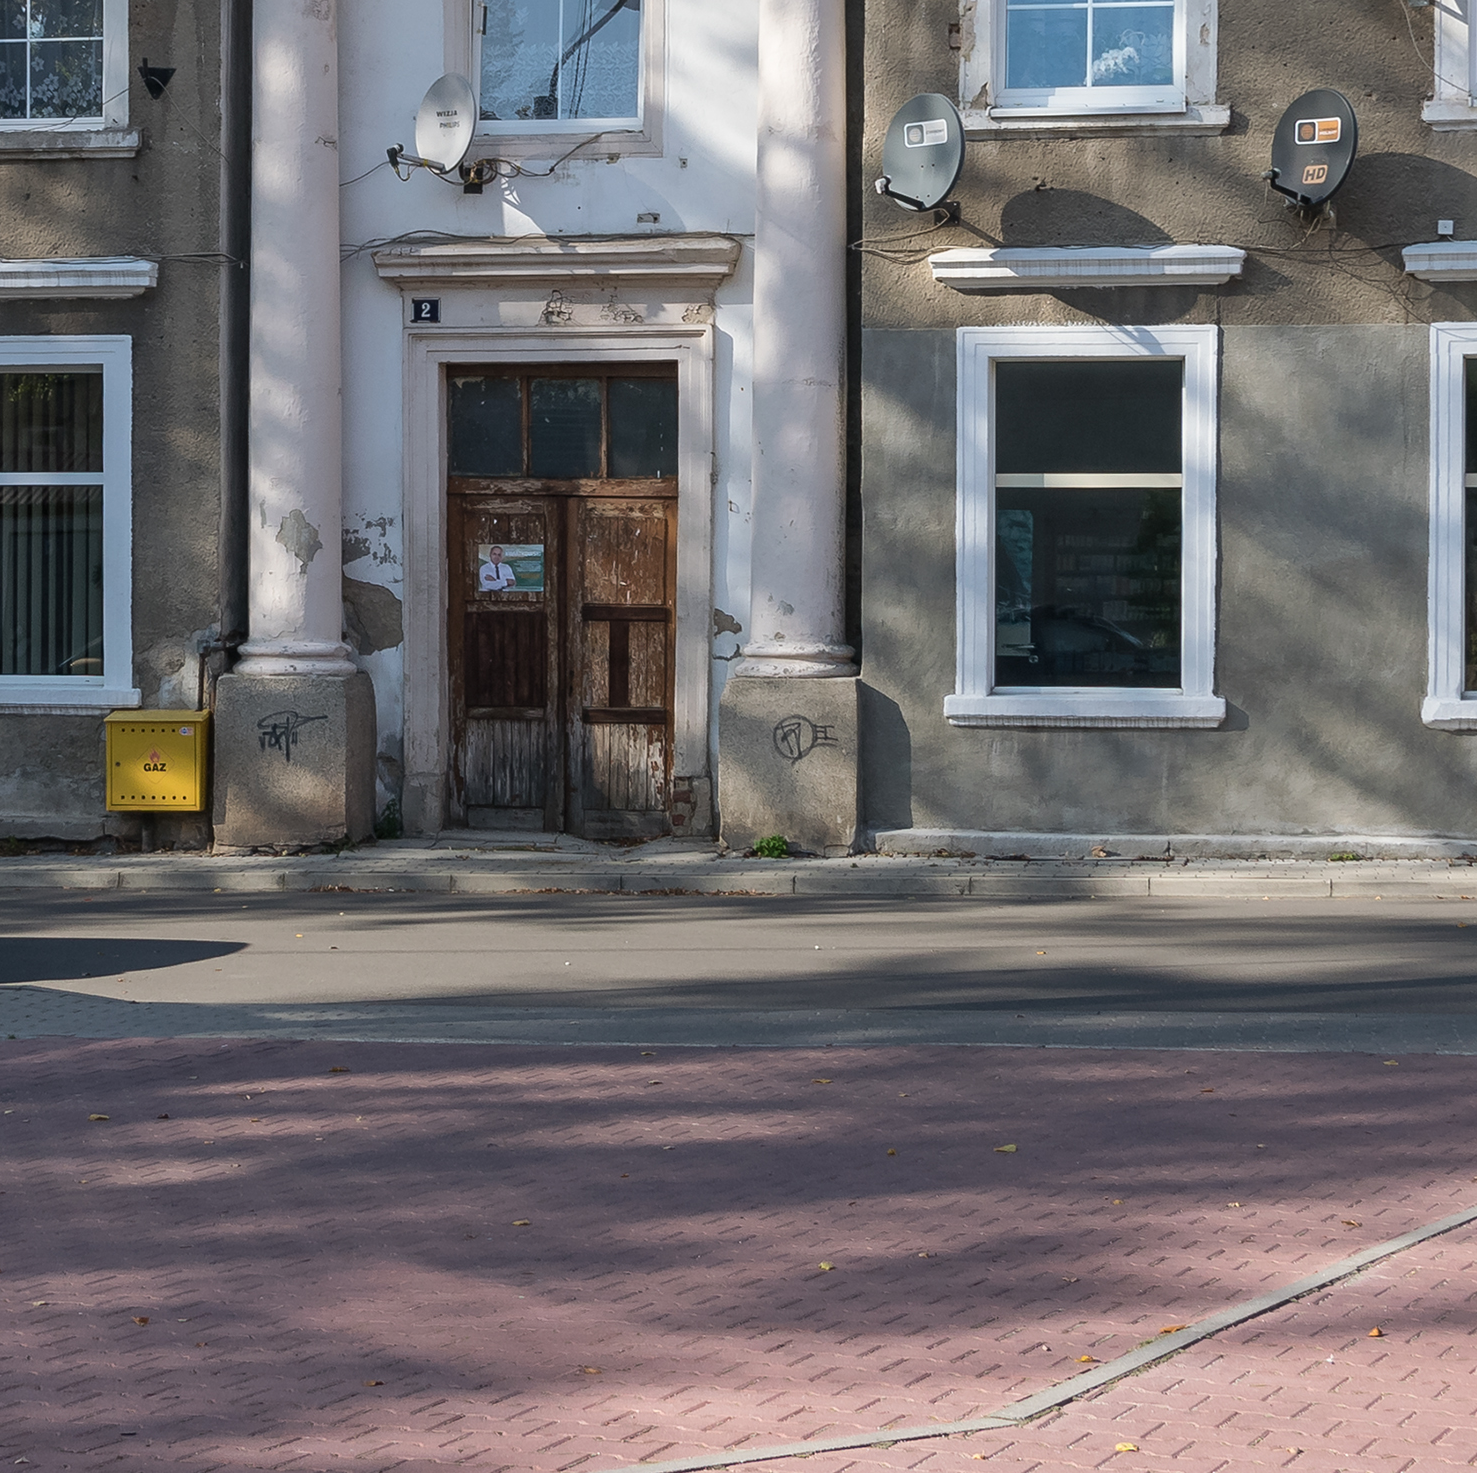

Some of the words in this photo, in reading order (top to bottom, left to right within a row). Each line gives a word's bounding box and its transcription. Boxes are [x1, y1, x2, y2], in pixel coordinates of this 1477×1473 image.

[1304, 166, 1326, 182] HD
[421, 302, 431, 317] 2
[143, 762, 167, 772] GAZ
